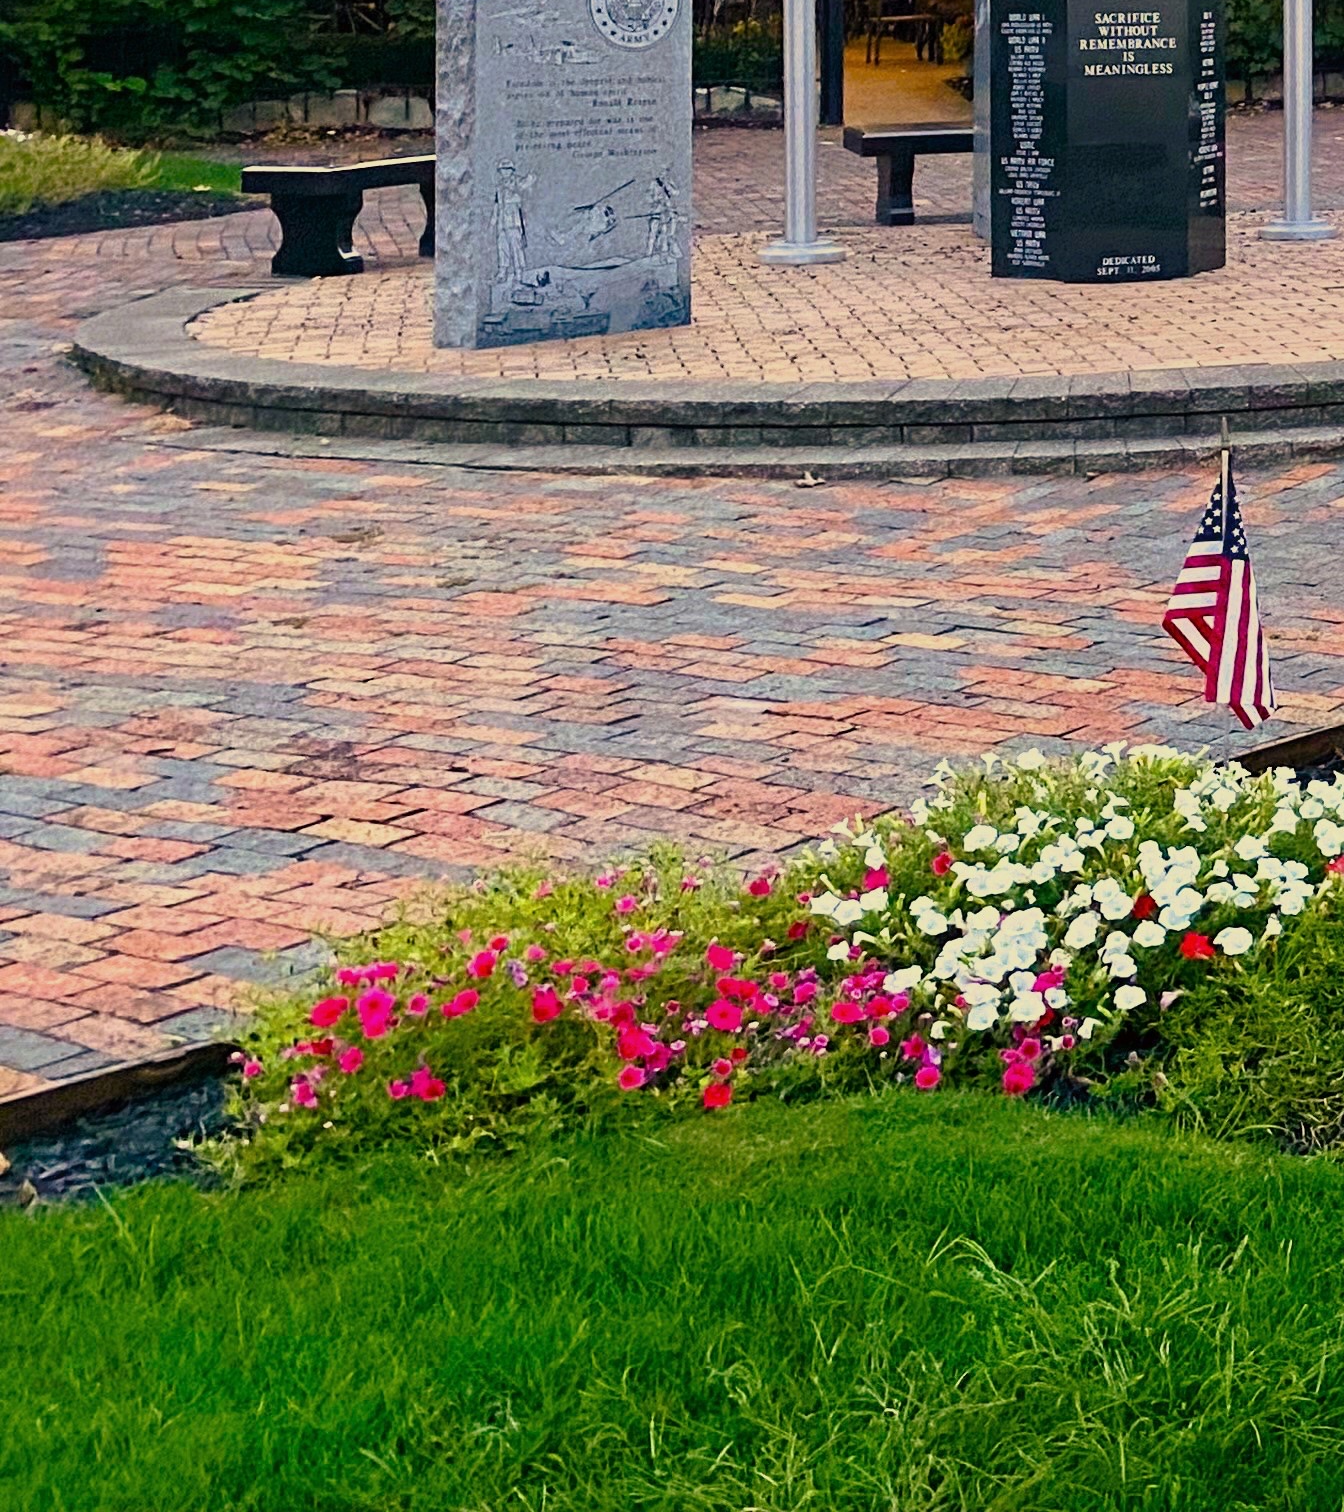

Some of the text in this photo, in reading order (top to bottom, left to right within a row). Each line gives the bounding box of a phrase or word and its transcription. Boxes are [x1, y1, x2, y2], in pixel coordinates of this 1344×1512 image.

[1094, 12, 1161, 24] SACRIFICE
[1098, 25, 1158, 37] WITHOUT
[620, 33, 651, 43] ARMY
[1079, 38, 1177, 50] REMEMBRANCE
[1122, 51, 1135, 62] IS
[1084, 63, 1173, 76] MEANINGLESS
[1102, 255, 1156, 266] DEDICATED
